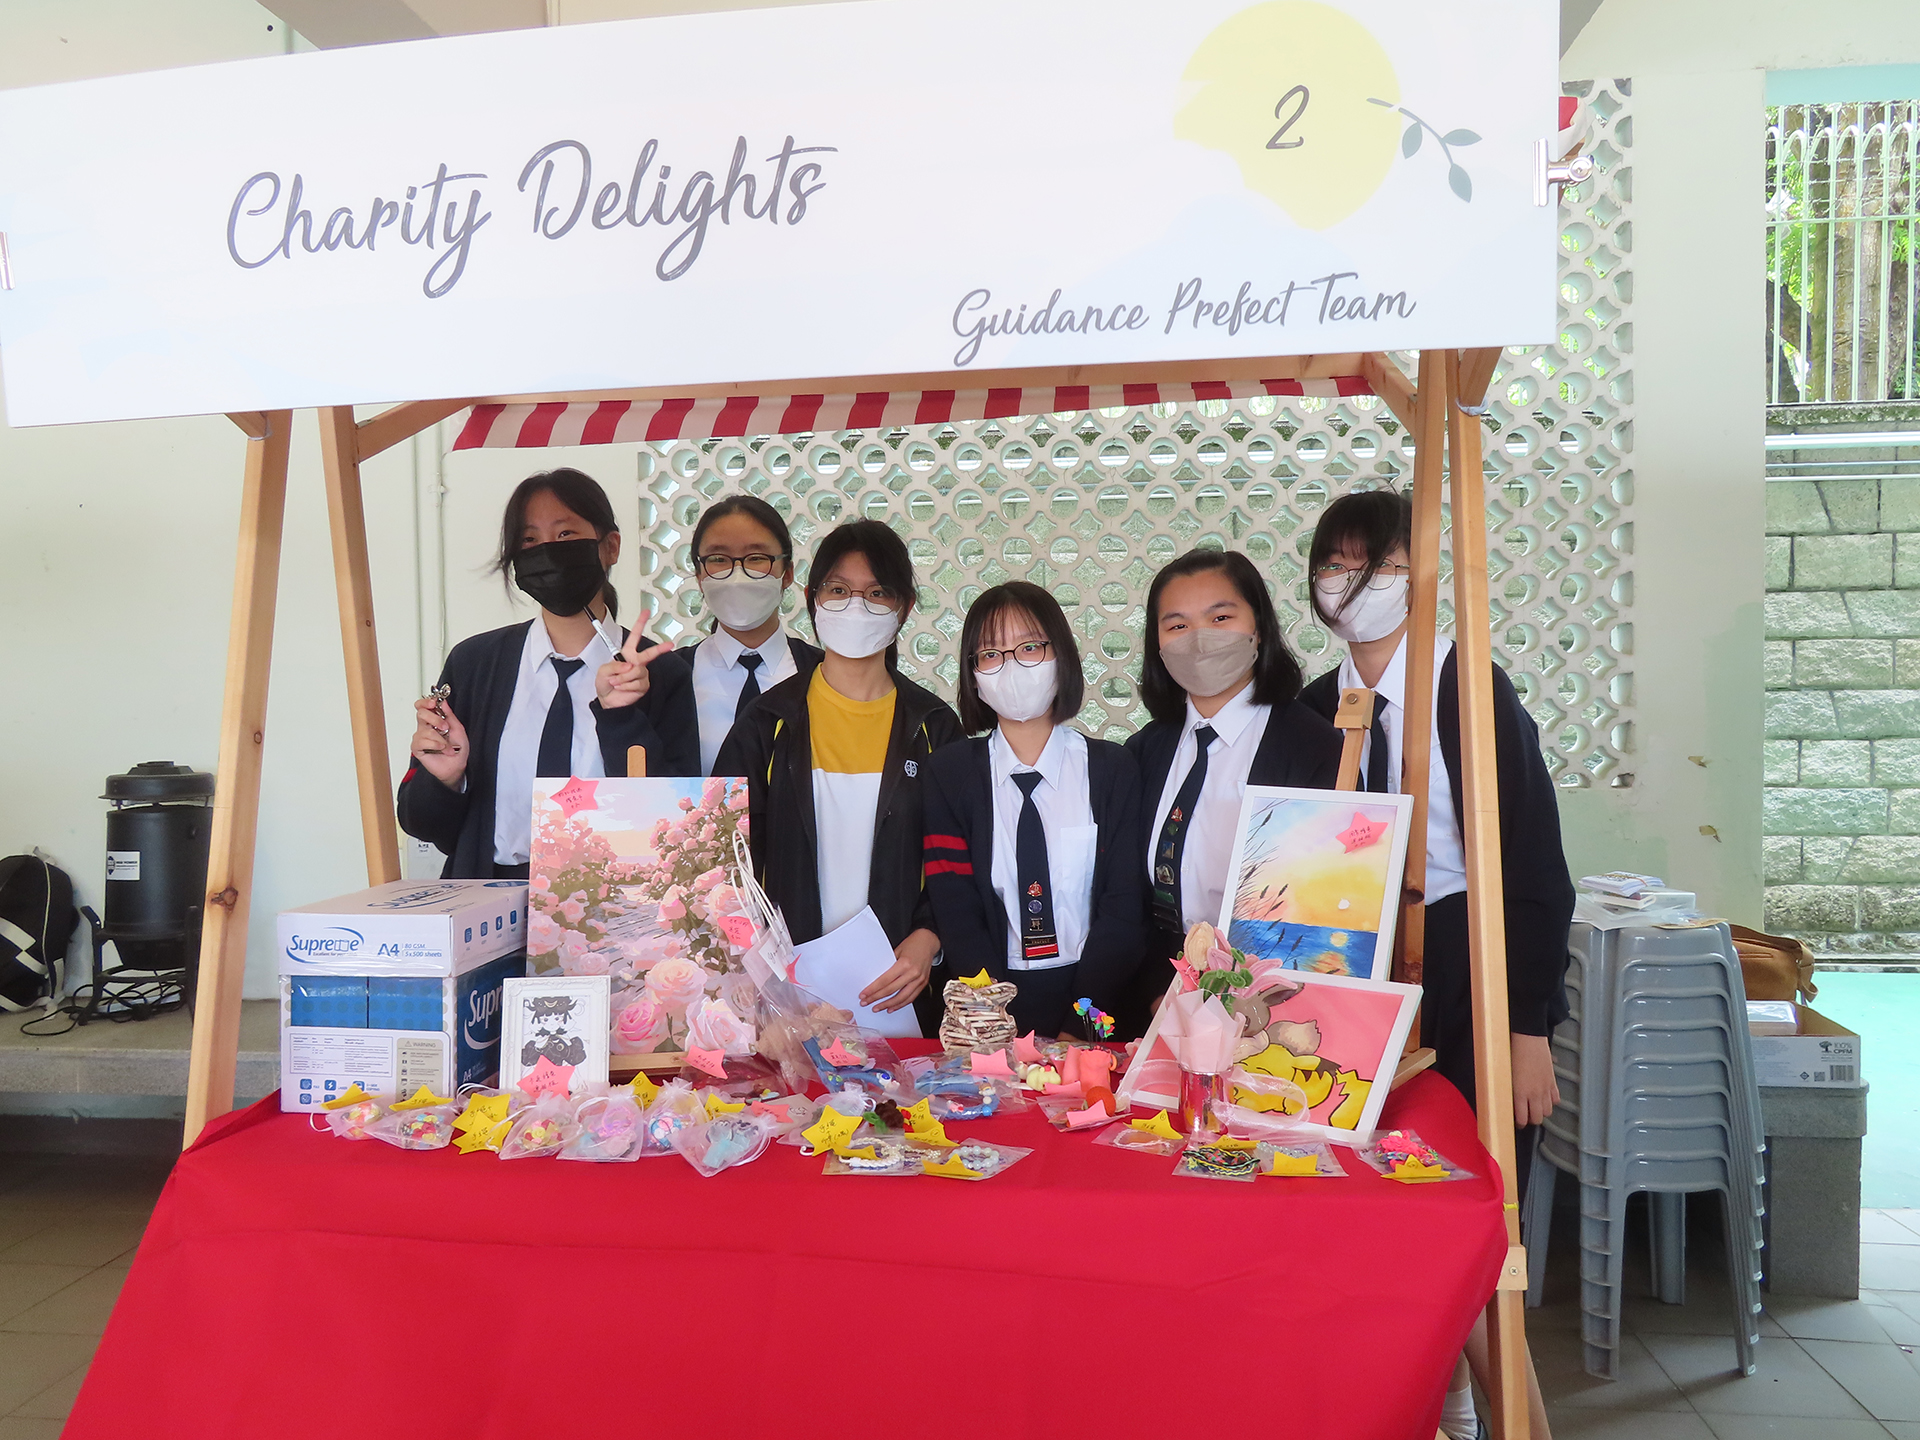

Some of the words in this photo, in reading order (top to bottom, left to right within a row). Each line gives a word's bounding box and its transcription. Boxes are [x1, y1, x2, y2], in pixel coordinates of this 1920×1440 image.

[1265, 84, 1310, 150] 2
[226, 163, 492, 299] Charity
[517, 135, 839, 282] Delights
[952, 288, 1150, 367] Guidance
[1163, 277, 1318, 336] Prefect
[1310, 271, 1417, 324] Team
[377, 943, 400, 957] A4
